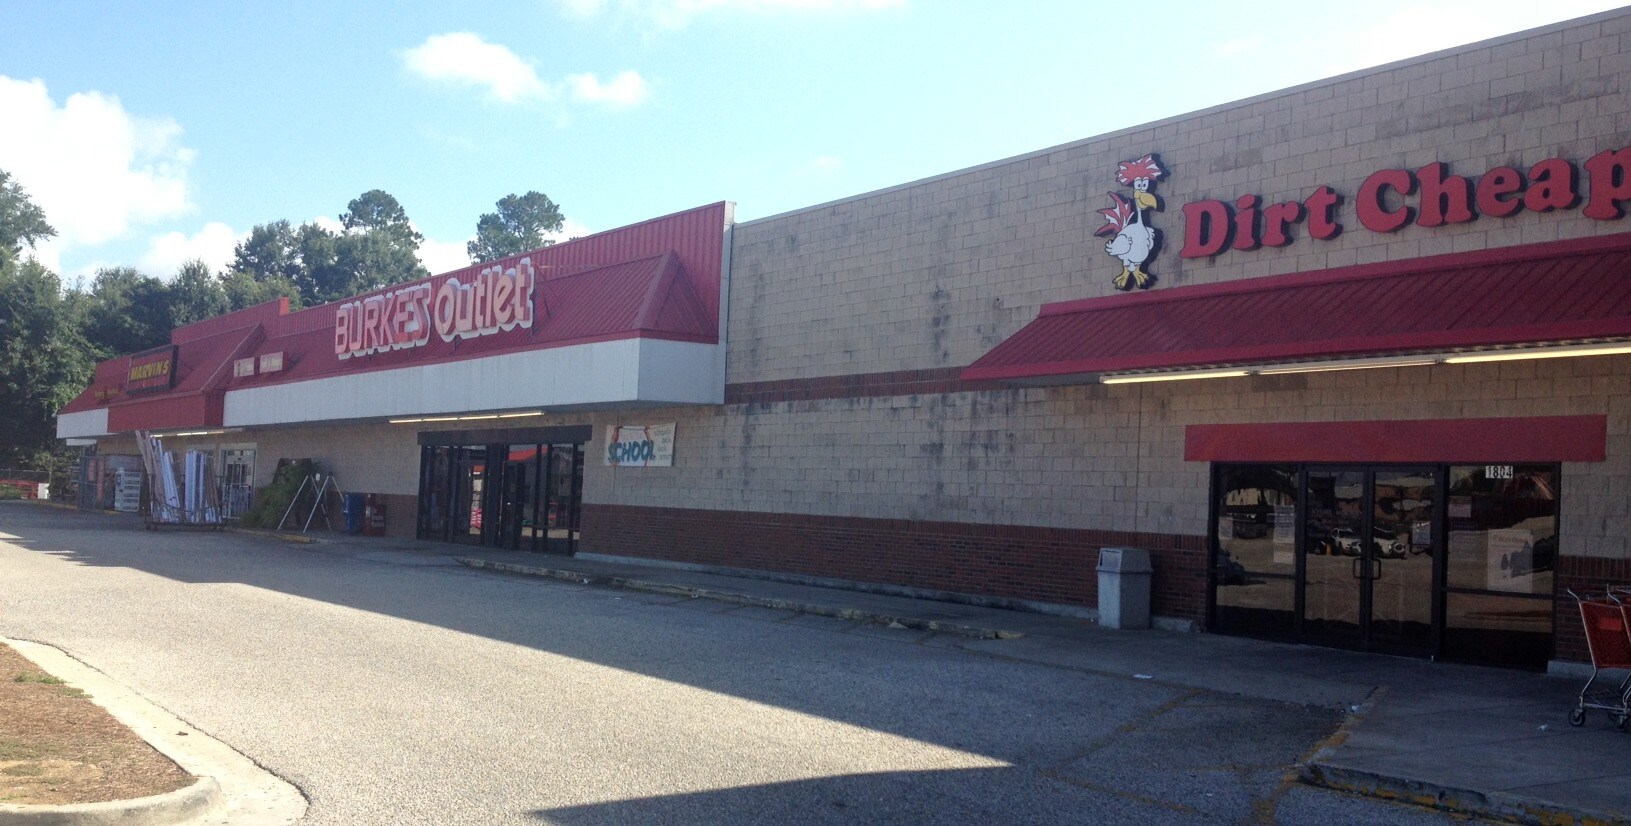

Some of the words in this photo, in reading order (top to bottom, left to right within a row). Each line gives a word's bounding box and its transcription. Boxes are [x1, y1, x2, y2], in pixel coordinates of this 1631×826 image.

[1180, 185, 1340, 259] Dirt
[1356, 146, 1631, 234] Cheap
[434, 258, 534, 342] Outlet
[608, 439, 655, 463] SCHOOL
[1487, 466, 1513, 478] 1804
